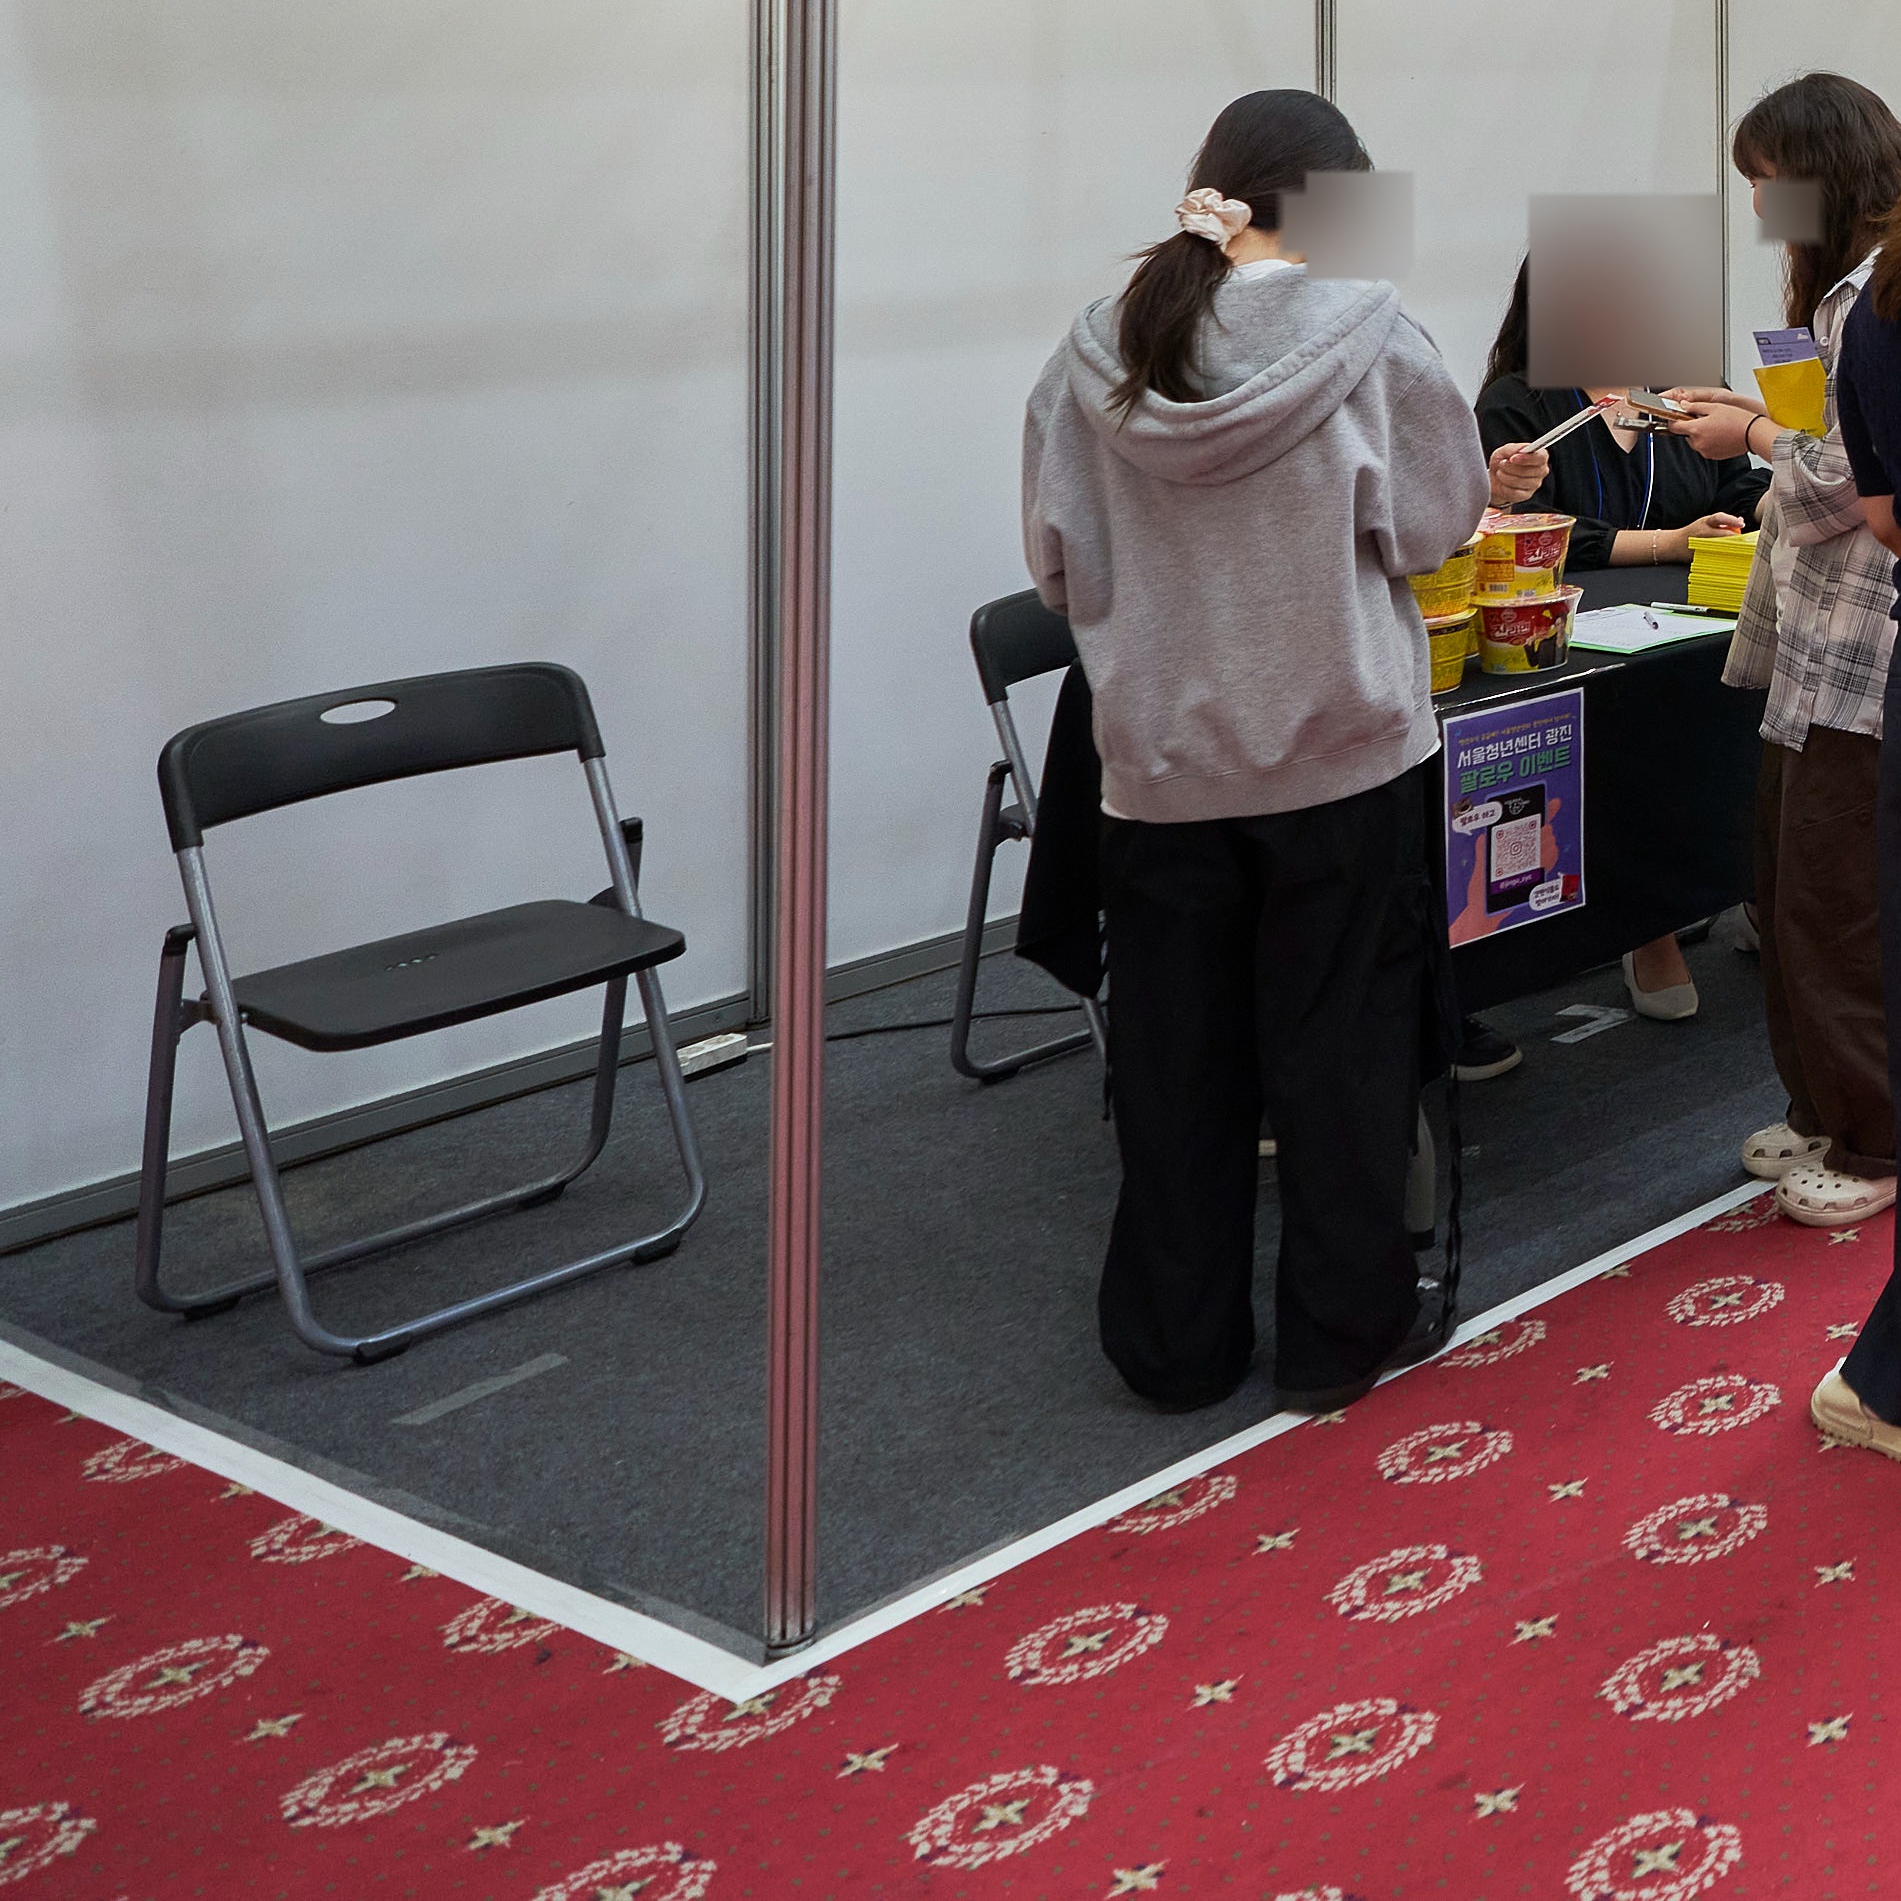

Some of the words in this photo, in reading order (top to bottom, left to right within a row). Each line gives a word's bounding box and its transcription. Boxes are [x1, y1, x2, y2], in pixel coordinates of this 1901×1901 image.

[1457, 732, 1541, 769] 서울청년센터
[1545, 724, 1573, 748] 광진
[1460, 761, 1513, 794] 팔로우
[1519, 745, 1571, 777] 이벤트
